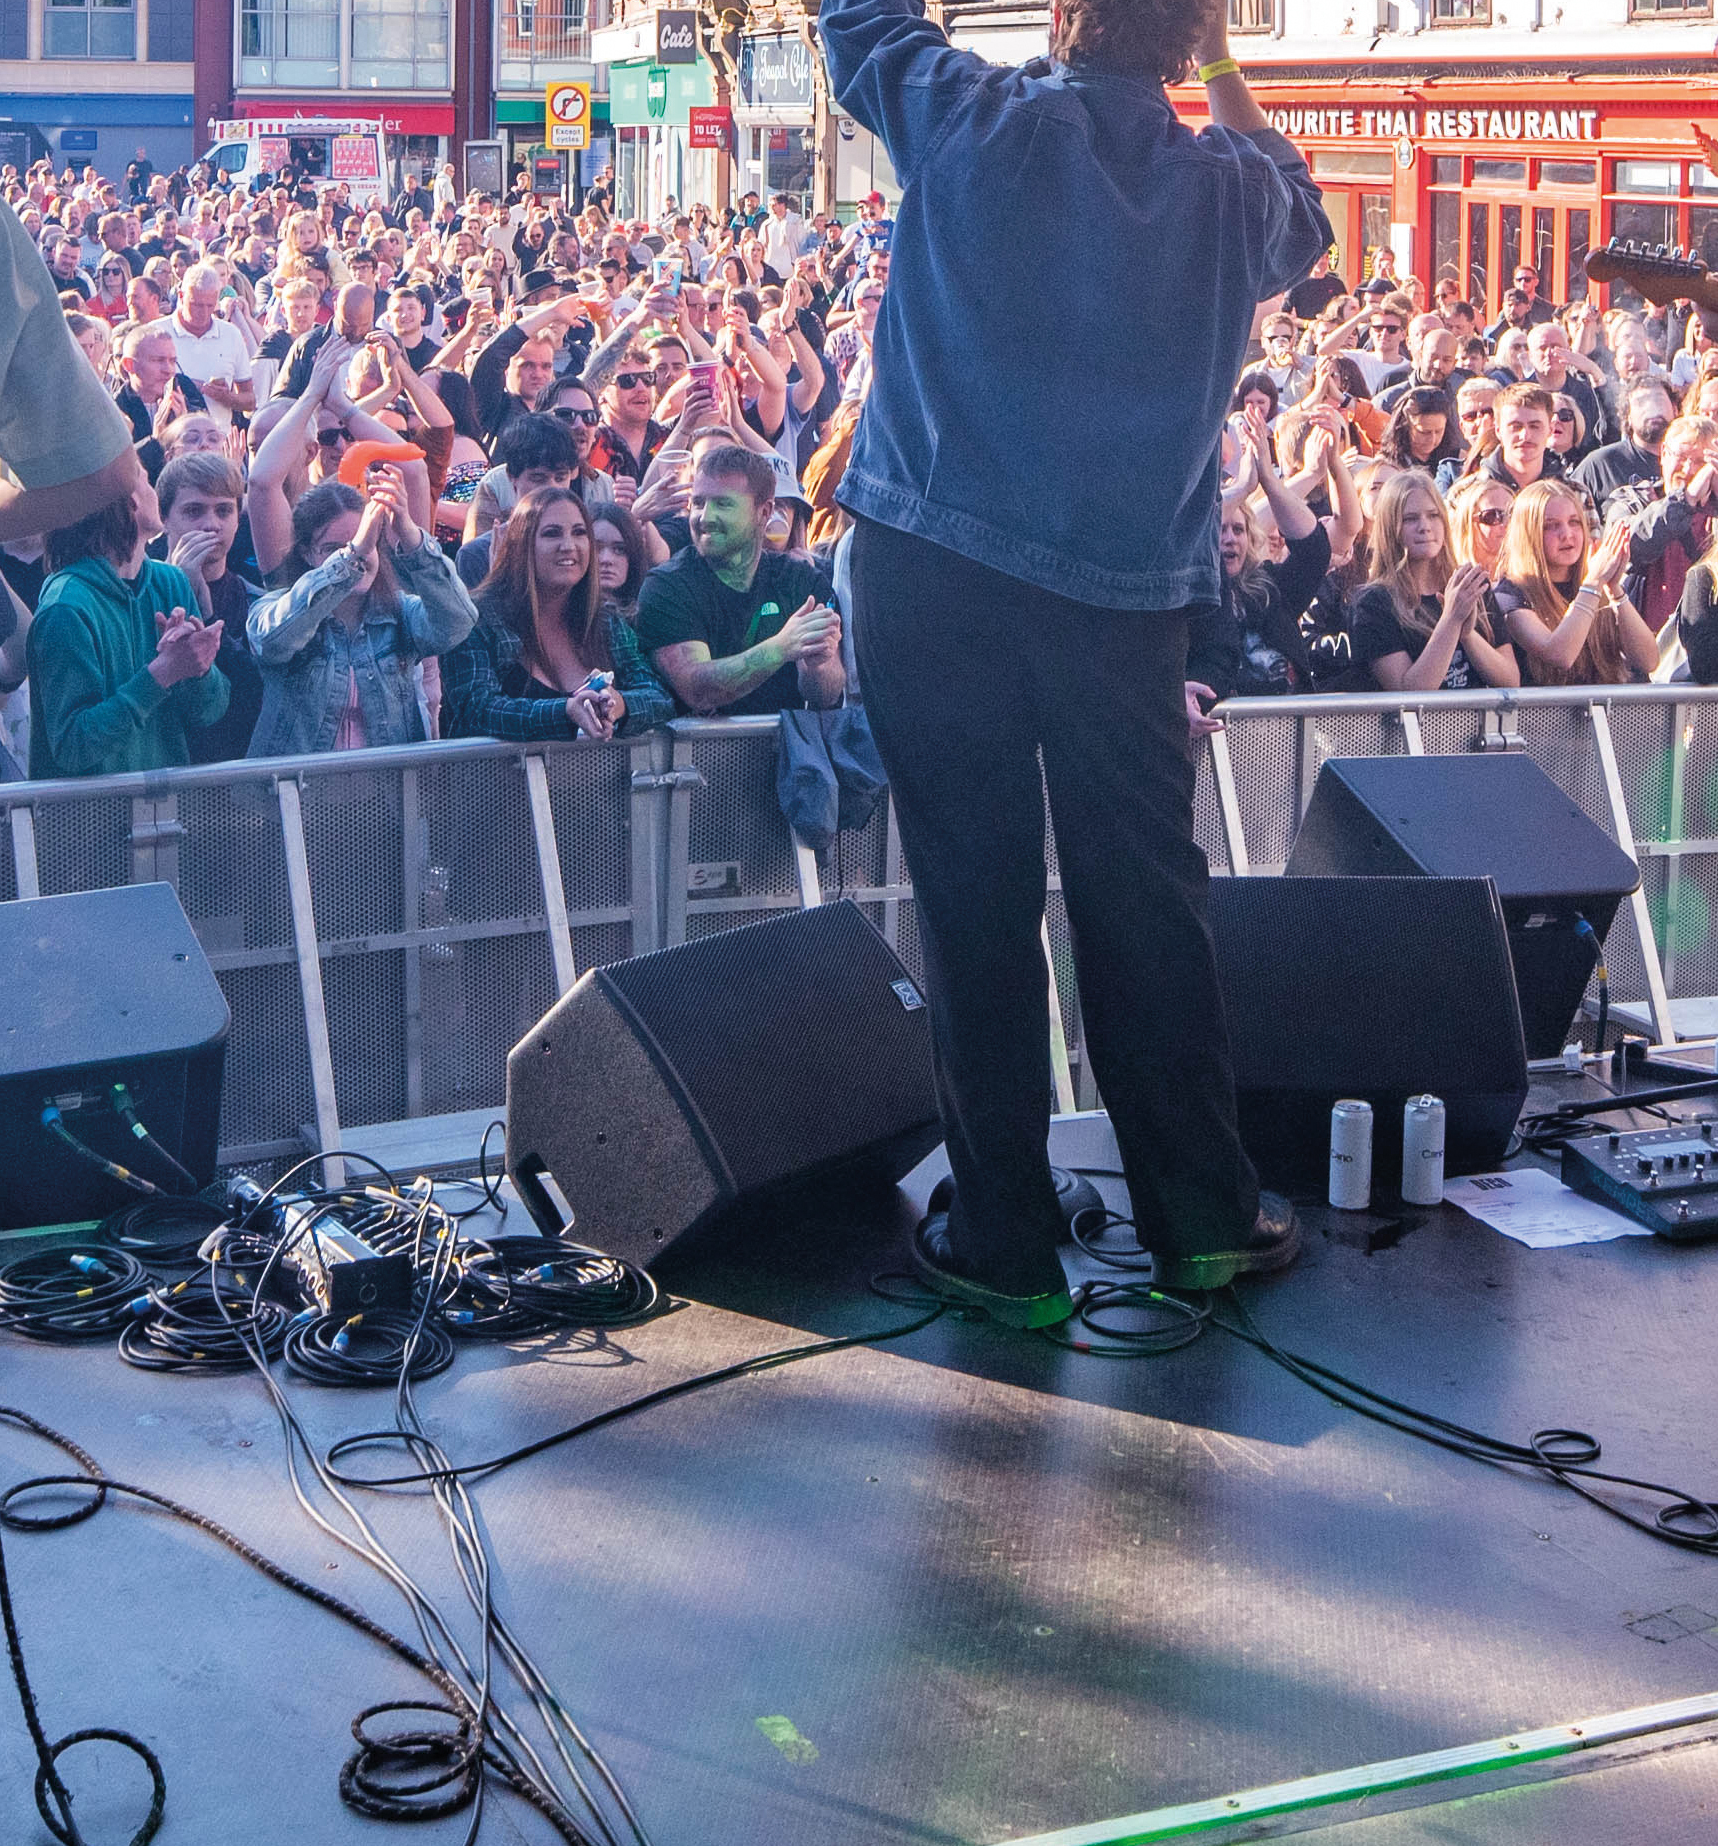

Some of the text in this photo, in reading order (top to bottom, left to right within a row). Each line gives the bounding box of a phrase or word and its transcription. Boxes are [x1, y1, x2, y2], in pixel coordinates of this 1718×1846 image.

[1361, 109, 1416, 136] THAI
[1426, 110, 1597, 139] RESTAURANT
[555, 128, 581, 137] Except
[694, 124, 720, 136] TO LET
[556, 136, 580, 144] cycles
